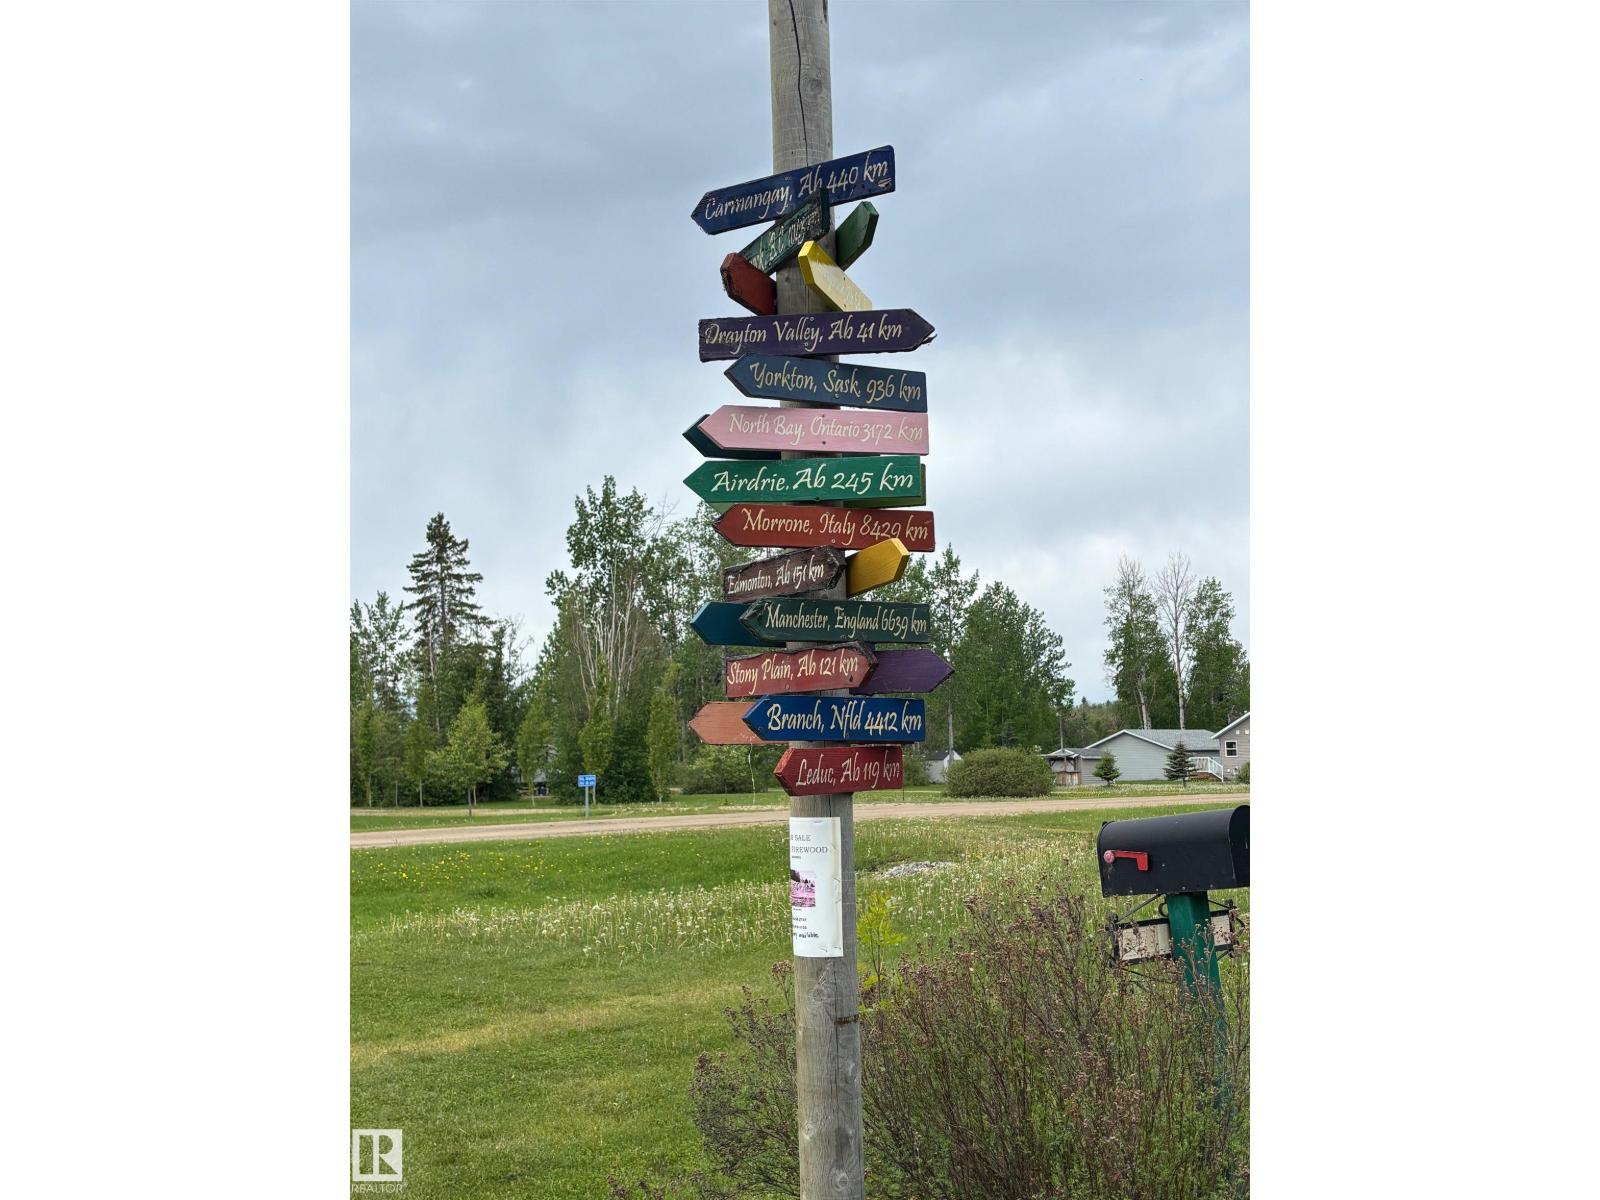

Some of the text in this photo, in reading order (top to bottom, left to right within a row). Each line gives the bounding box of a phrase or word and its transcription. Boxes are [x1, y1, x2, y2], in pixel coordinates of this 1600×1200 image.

[704, 185, 792, 219] Carmangay,
[826, 166, 859, 193] 440
[863, 152, 888, 182] km
[704, 313, 902, 354] Drayton Valley, Ab 41 km
[750, 362, 817, 393] Yorkton,
[866, 374, 895, 403] 936
[900, 373, 921, 401] km
[729, 413, 923, 446] North Bay, Ontario 3172 km
[792, 463, 826, 490] Ab
[831, 471, 874, 495] 245
[879, 462, 913, 491] km
[741, 508, 928, 544] Morrone, Italy 8429 km
[727, 554, 824, 594] Edmonton, Ab 151 km
[763, 601, 927, 639] Manchester, England 6639 km
[727, 650, 858, 694] Stony Plain, Ab 121 km
[766, 699, 922, 738] Branch, Nfld 4412 km
[795, 749, 900, 788] Leduc, Ab 119 km
